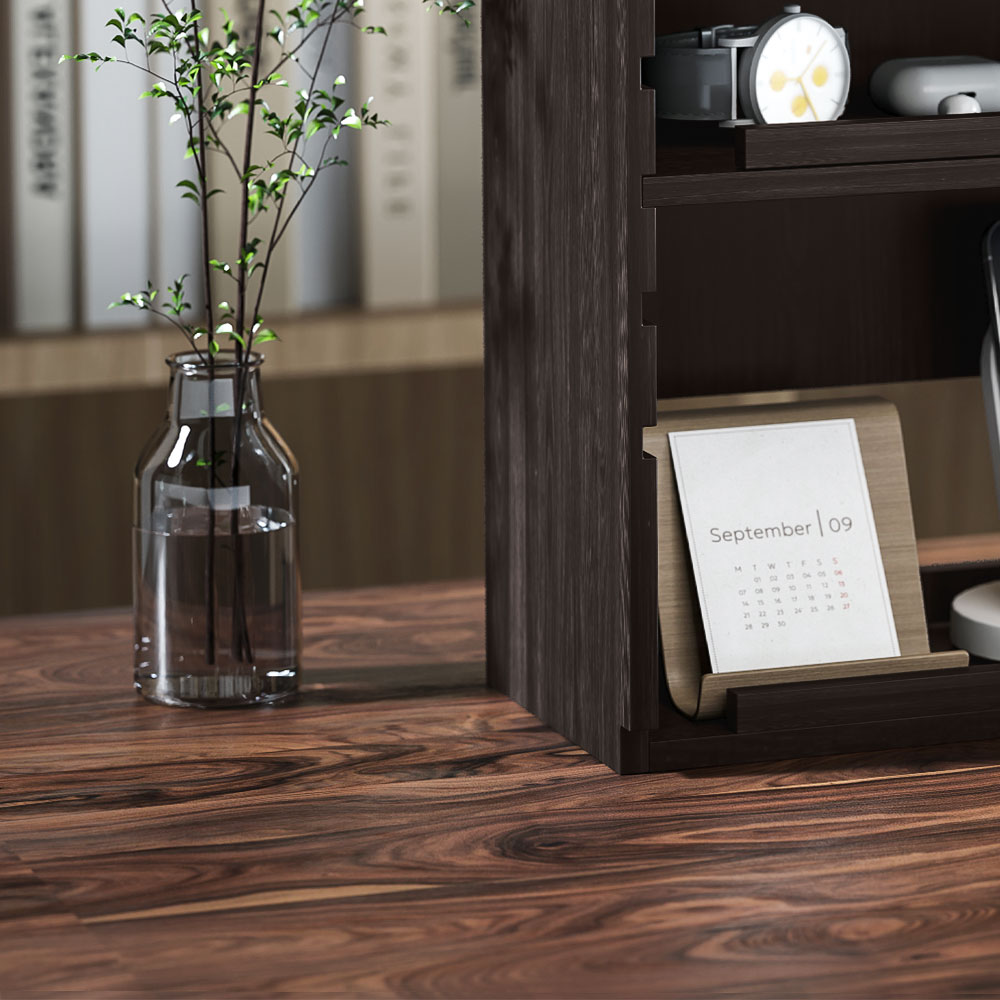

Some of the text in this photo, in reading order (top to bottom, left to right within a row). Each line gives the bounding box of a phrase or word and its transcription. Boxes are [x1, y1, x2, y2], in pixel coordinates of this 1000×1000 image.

[710, 516, 853, 545] September 09
[832, 557, 838, 565] S
